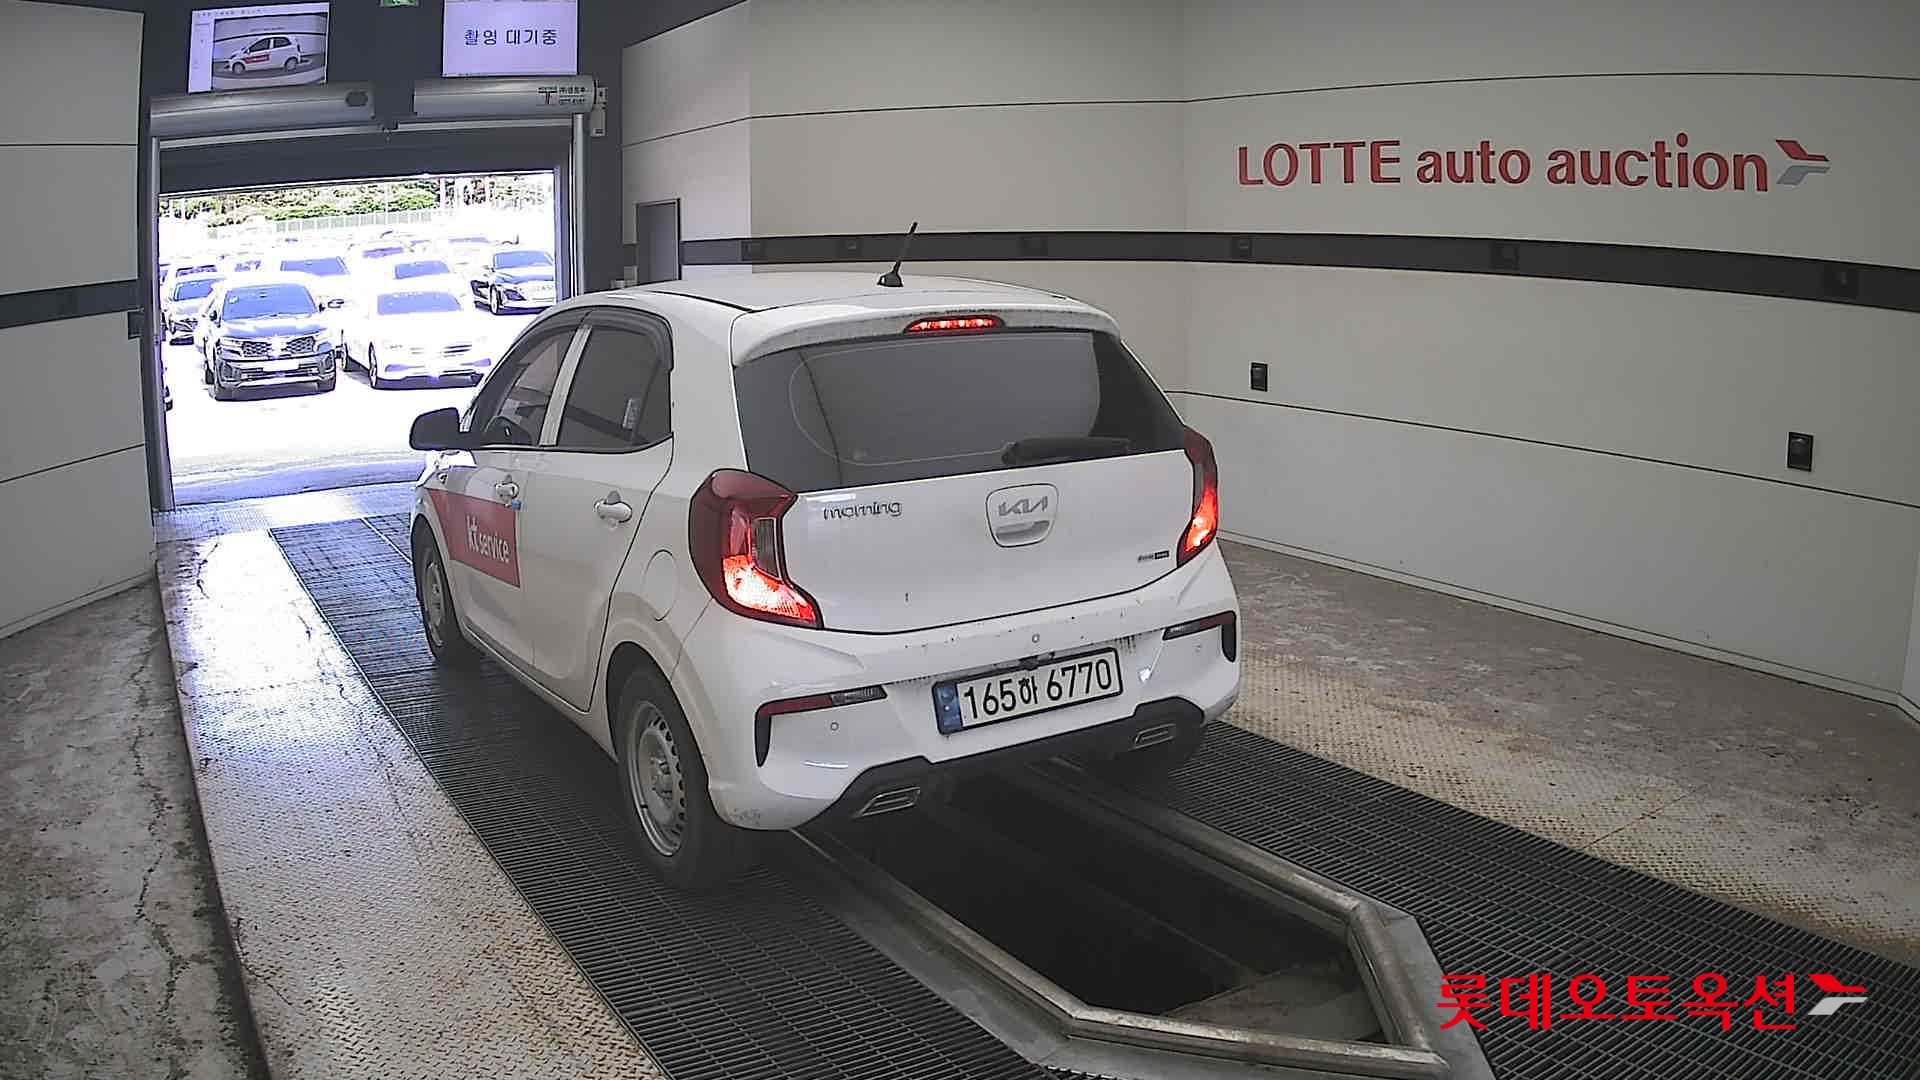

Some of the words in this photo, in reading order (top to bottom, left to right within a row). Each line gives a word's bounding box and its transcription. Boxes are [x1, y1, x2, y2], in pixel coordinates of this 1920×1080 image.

[464, 29, 497, 46] 촬영
[506, 29, 558, 46] 대기중
[1239, 140, 1400, 186] LOTTE
[1417, 141, 1532, 185] auto
[1547, 132, 1767, 192] auction
[823, 501, 902, 520] morning
[479, 531, 511, 564] service
[964, 675, 1038, 719] 165하
[1046, 658, 1112, 701] 6770
